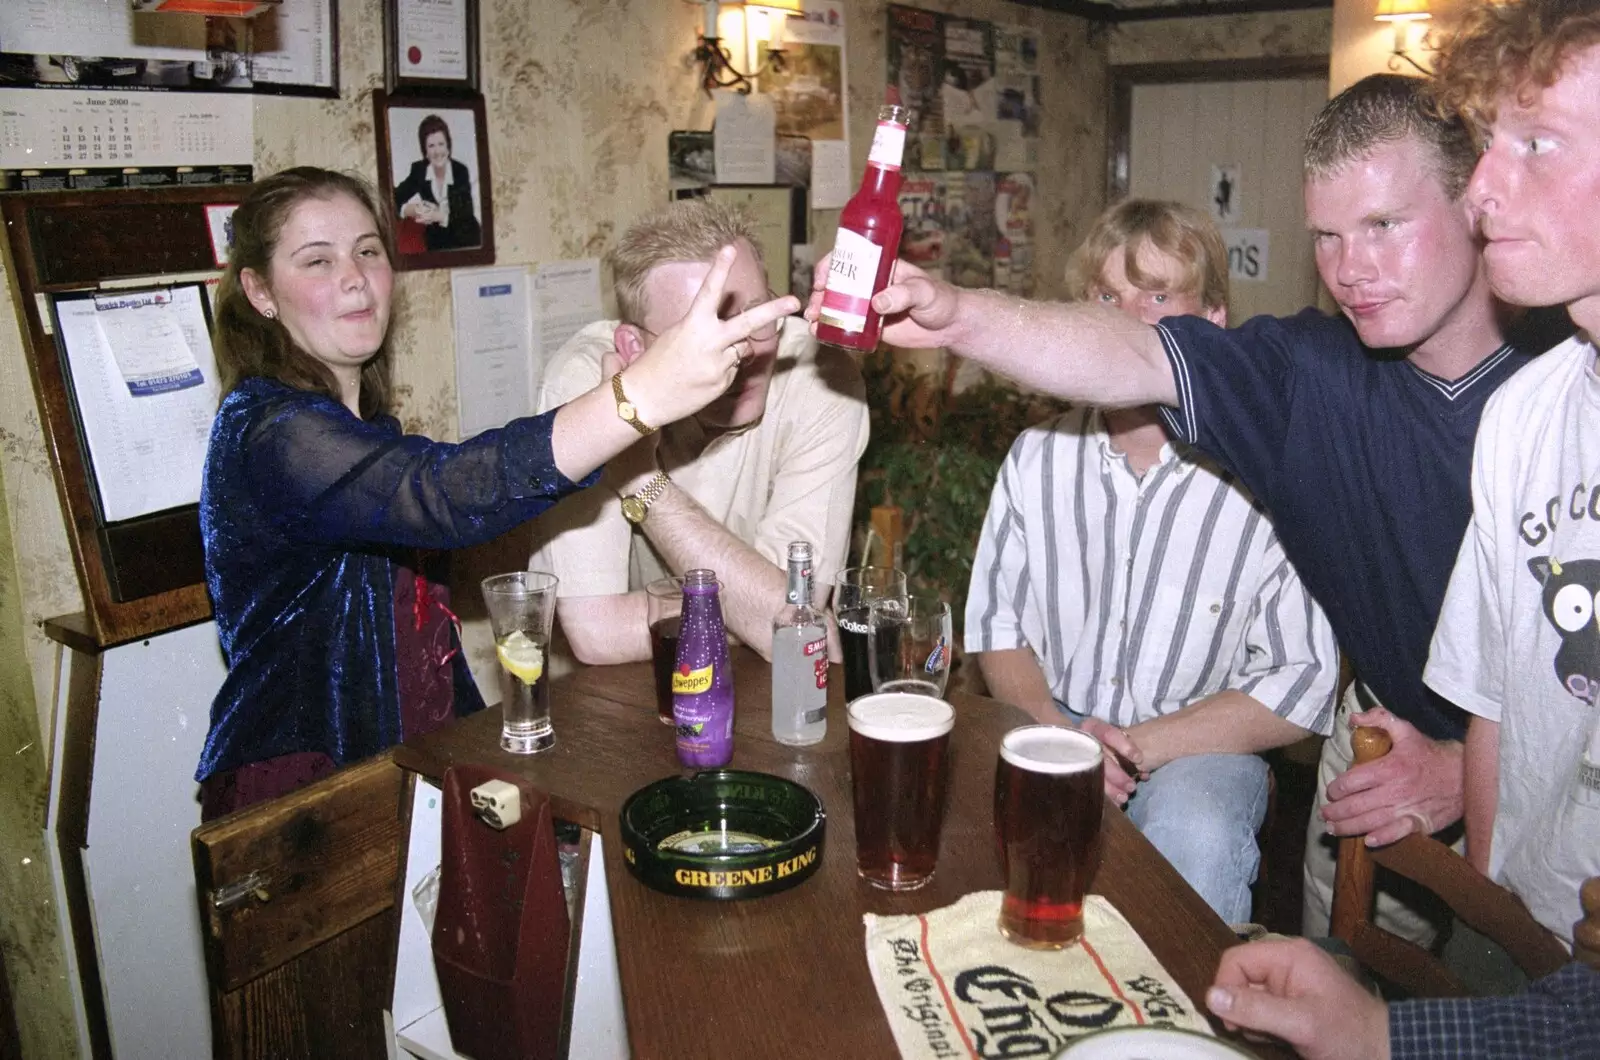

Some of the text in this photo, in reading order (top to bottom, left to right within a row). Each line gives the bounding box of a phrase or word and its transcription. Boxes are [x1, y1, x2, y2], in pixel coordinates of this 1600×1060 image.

[86, 97, 107, 105] June
[109, 98, 129, 106] 2000
[1227, 238, 1259, 277] n's
[675, 845, 817, 887] GREENE KING
[901, 978, 962, 1060] Original
[954, 965, 1050, 1060] Eng
